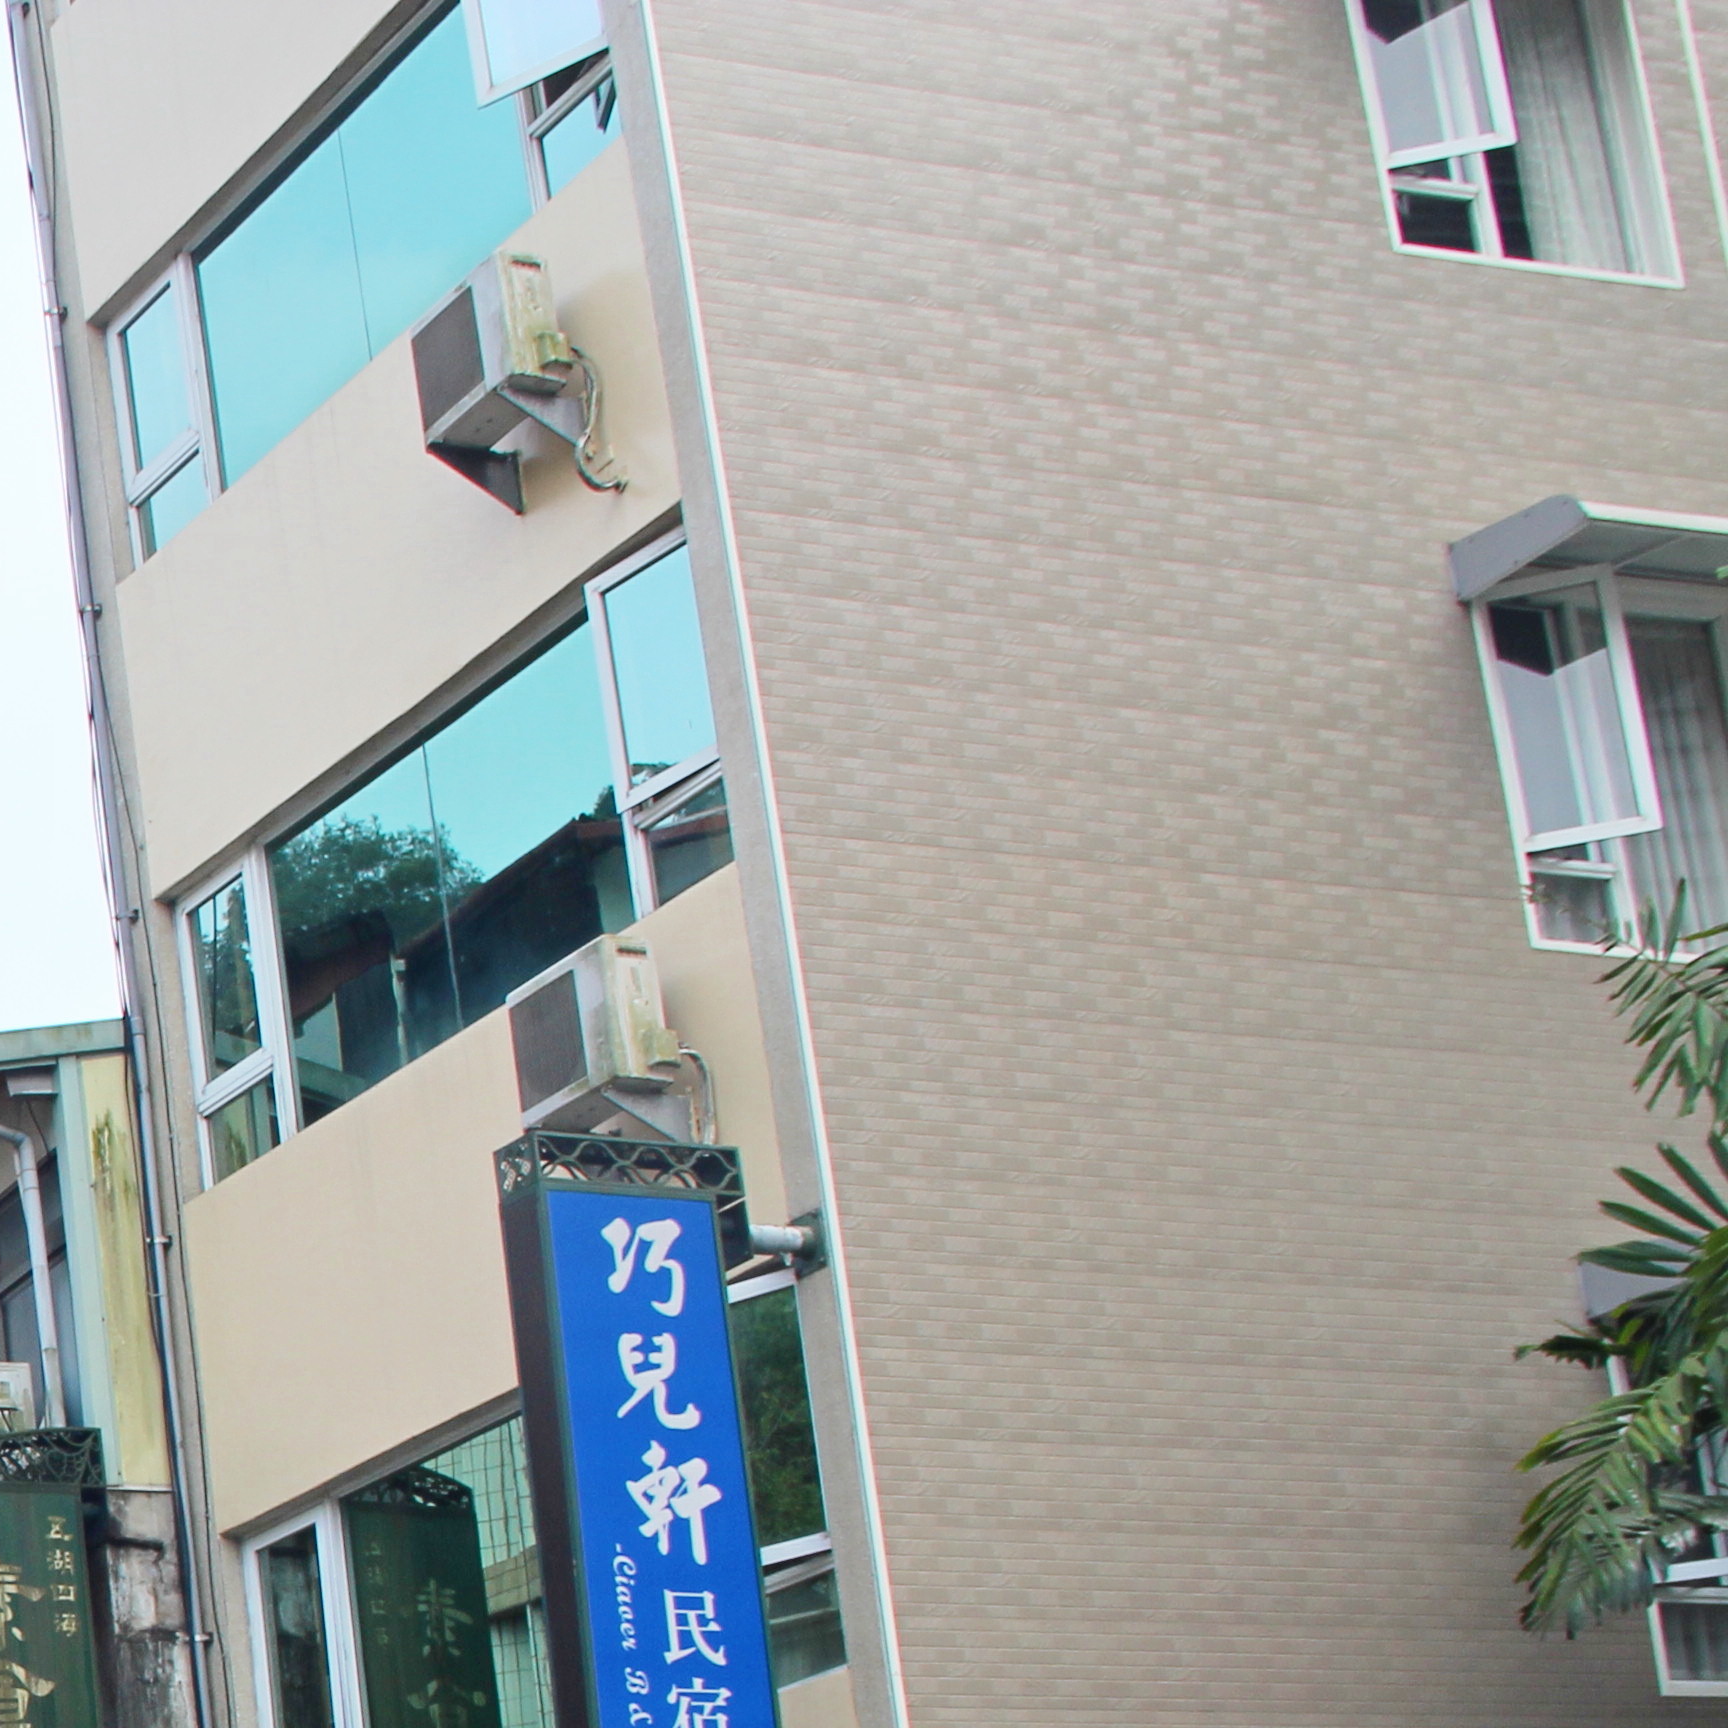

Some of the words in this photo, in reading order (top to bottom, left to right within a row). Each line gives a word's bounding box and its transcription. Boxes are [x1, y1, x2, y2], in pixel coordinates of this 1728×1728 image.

[600, 1216, 722, 1566] 巧兒軒
[45, 1515, 79, 1638] 五湖四海
